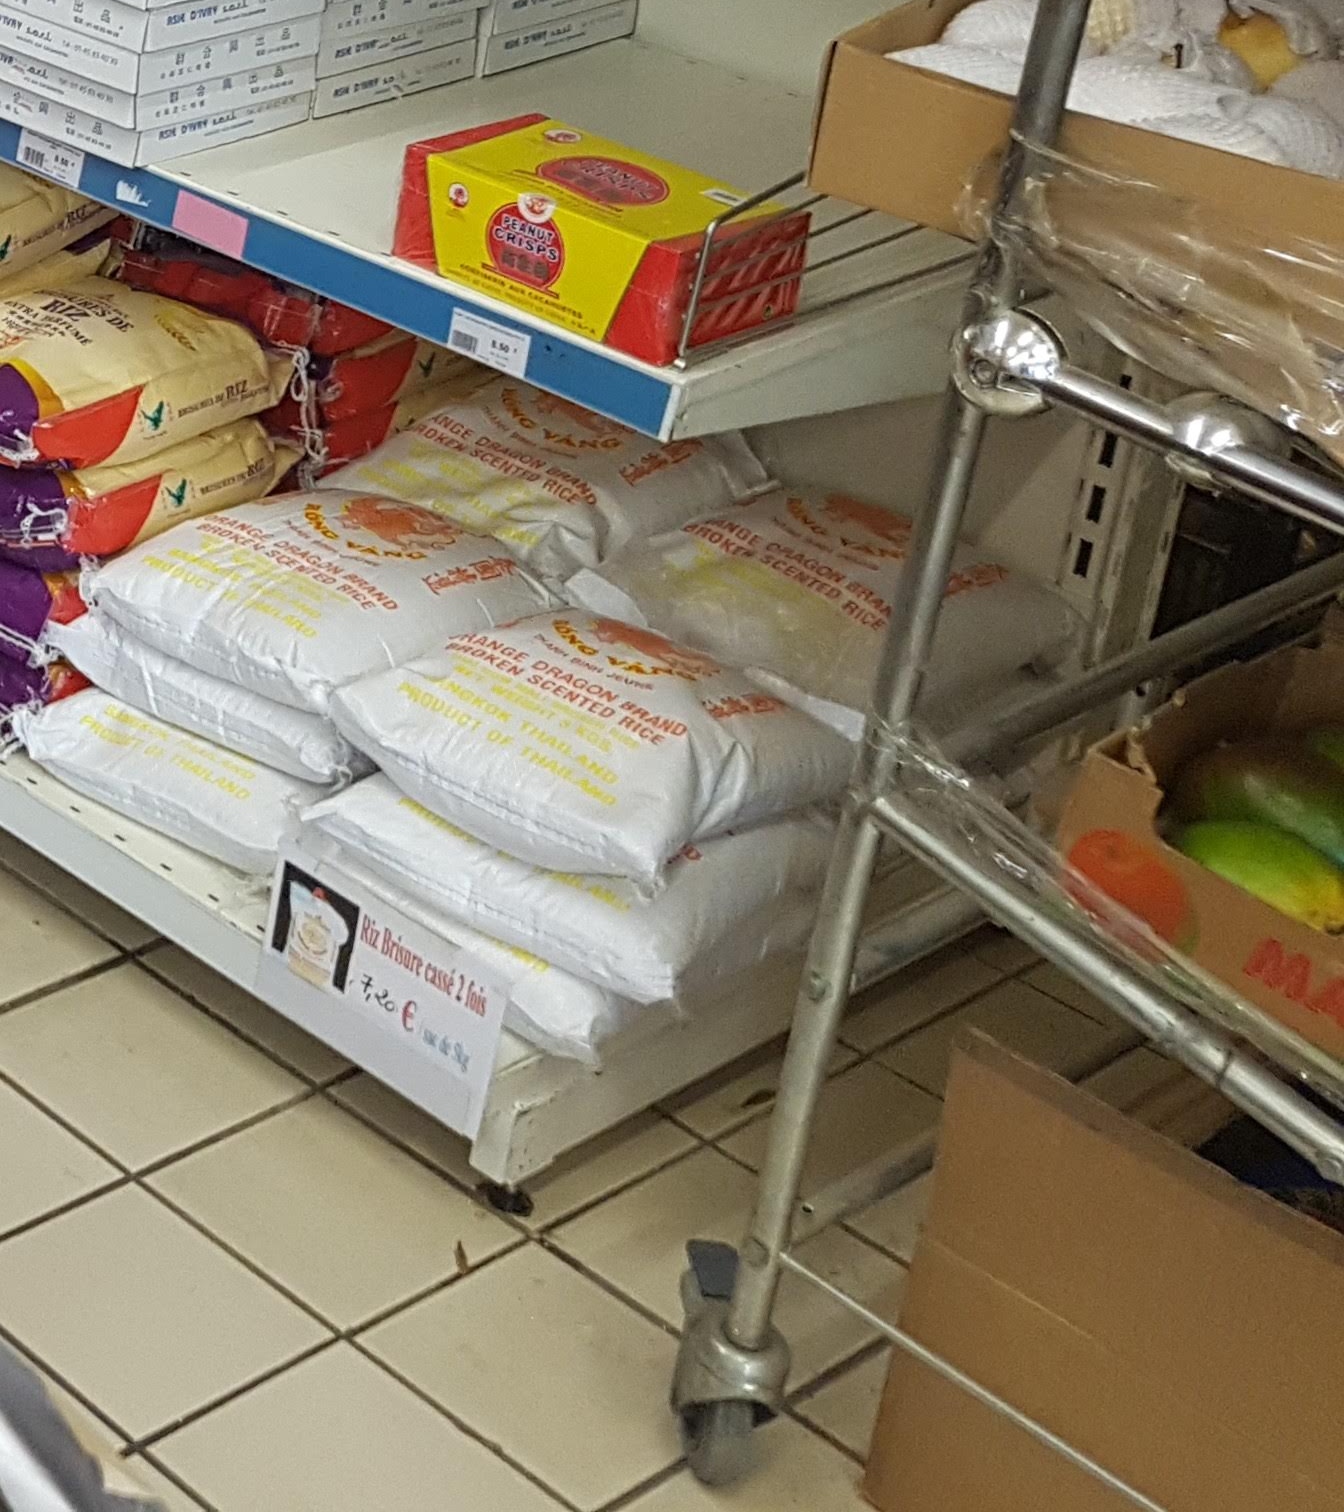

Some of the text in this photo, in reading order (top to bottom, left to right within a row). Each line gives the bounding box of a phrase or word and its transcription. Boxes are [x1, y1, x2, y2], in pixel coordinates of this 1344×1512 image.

[492, 227, 559, 263] CRISPS
[501, 212, 556, 245] PEANUT
[40, 298, 92, 323] RIZ
[107, 315, 135, 334] DE
[426, 411, 474, 441] ANGE
[541, 478, 581, 505] RICE
[195, 522, 377, 612] BROKEN SCENTED RICE
[273, 539, 343, 577] DRAGON
[341, 568, 399, 612] BRAND
[759, 553, 843, 601] SCENTED
[841, 599, 891, 632] RICE
[845, 580, 894, 619] BRAN
[426, 674, 515, 724] ANGKOK
[443, 640, 668, 747] BROKEN SCENTED RICE
[531, 659, 619, 705] DRAGON
[619, 699, 689, 740] BRAND
[361, 913, 489, 1019] Riz Brisure cassé 2 fois
[401, 999, 418, 1033] €
